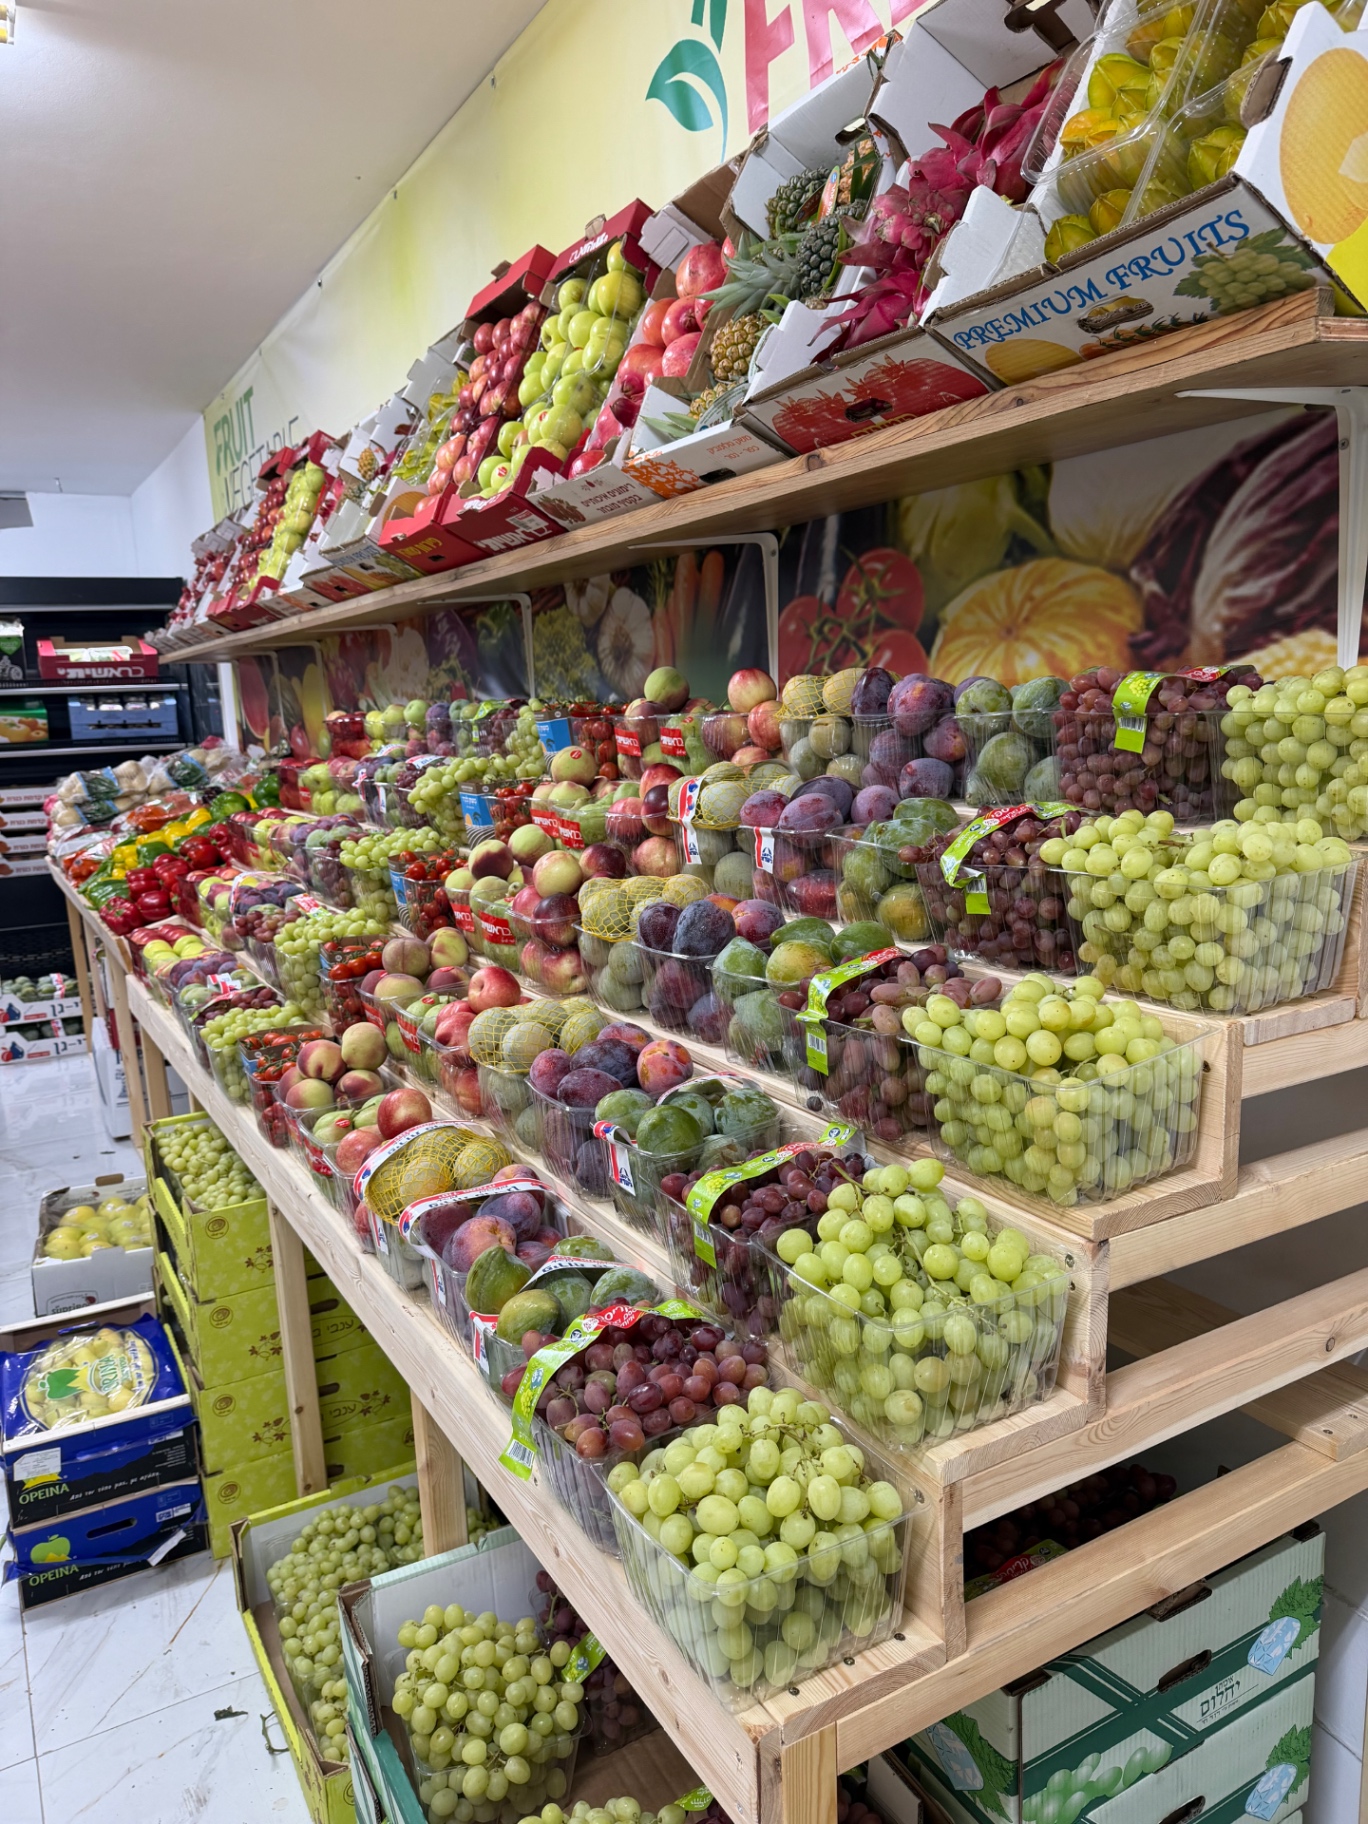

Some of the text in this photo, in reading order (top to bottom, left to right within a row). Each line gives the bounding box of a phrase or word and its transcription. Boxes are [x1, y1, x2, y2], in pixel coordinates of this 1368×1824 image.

[954, 209, 1251, 349] PREMIUM FRUITS
[213, 386, 255, 476] FRUIT
[326, 1319, 356, 1335] ענבי
[328, 1403, 357, 1419] ענבי
[18, 1482, 70, 1505] OPEINA
[28, 1564, 79, 1587] OPEINA
[1200, 1680, 1241, 1717] יהלום
